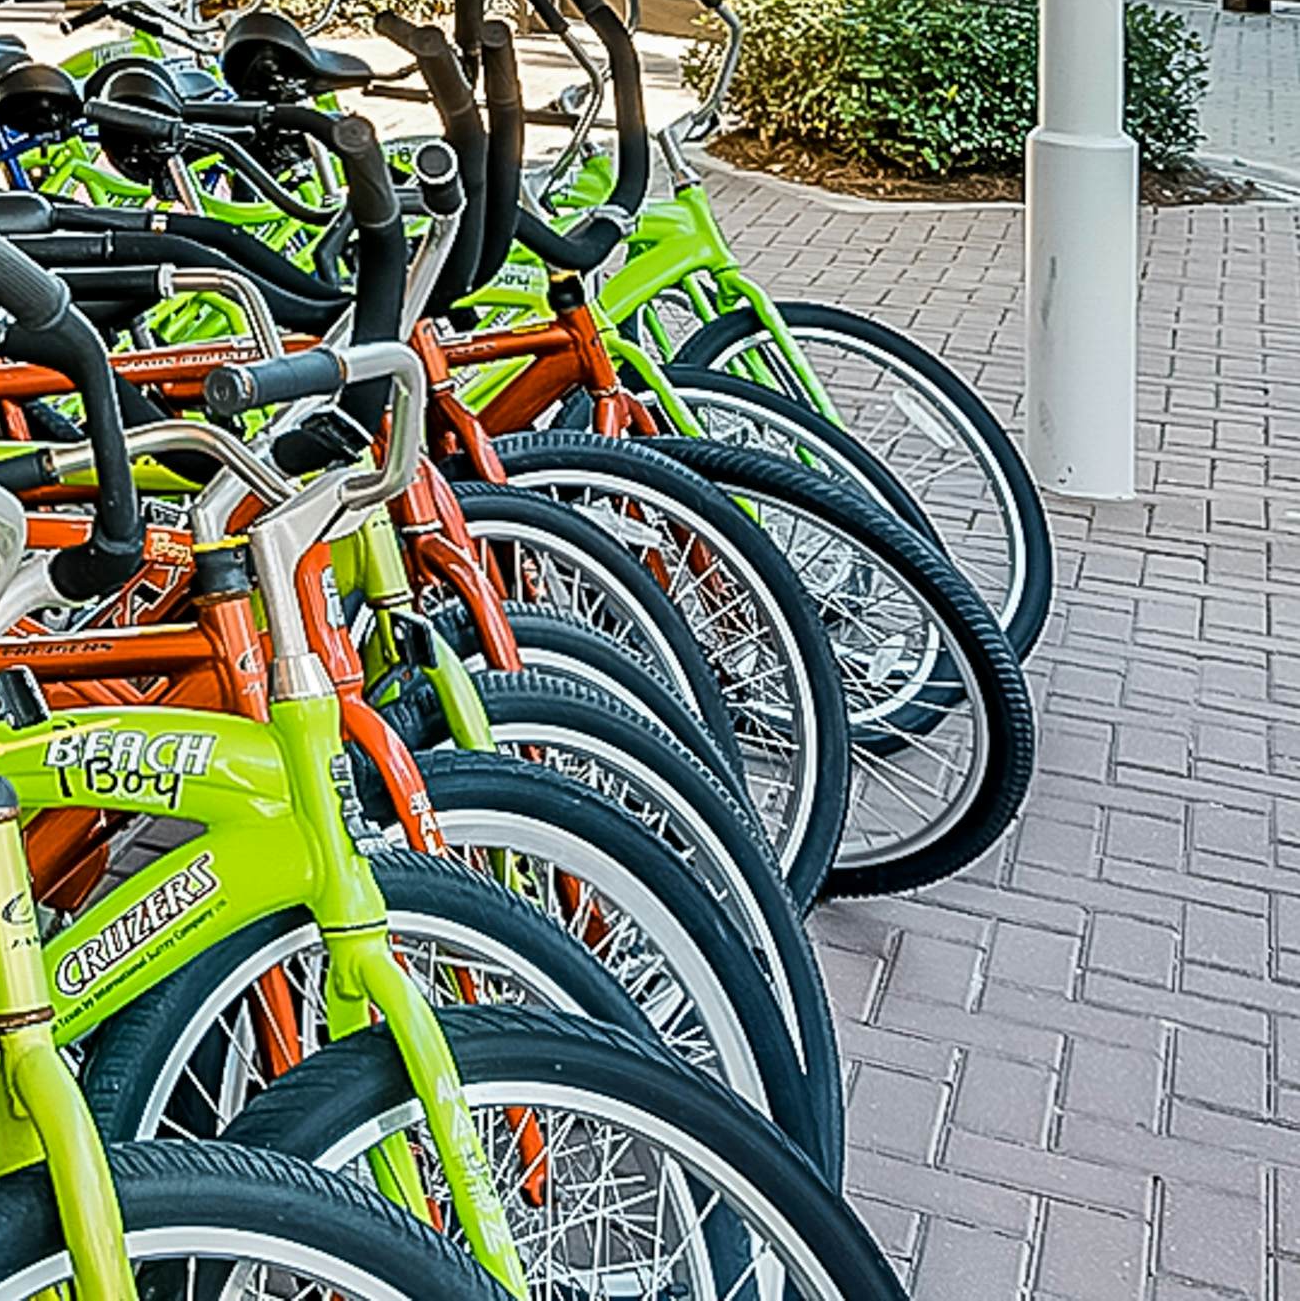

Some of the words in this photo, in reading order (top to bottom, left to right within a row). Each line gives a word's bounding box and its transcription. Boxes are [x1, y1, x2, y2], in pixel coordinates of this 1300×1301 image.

[43, 729, 217, 776] BEACH
[85, 756, 181, 810] Boy
[54, 852, 218, 996] CRUZERS
